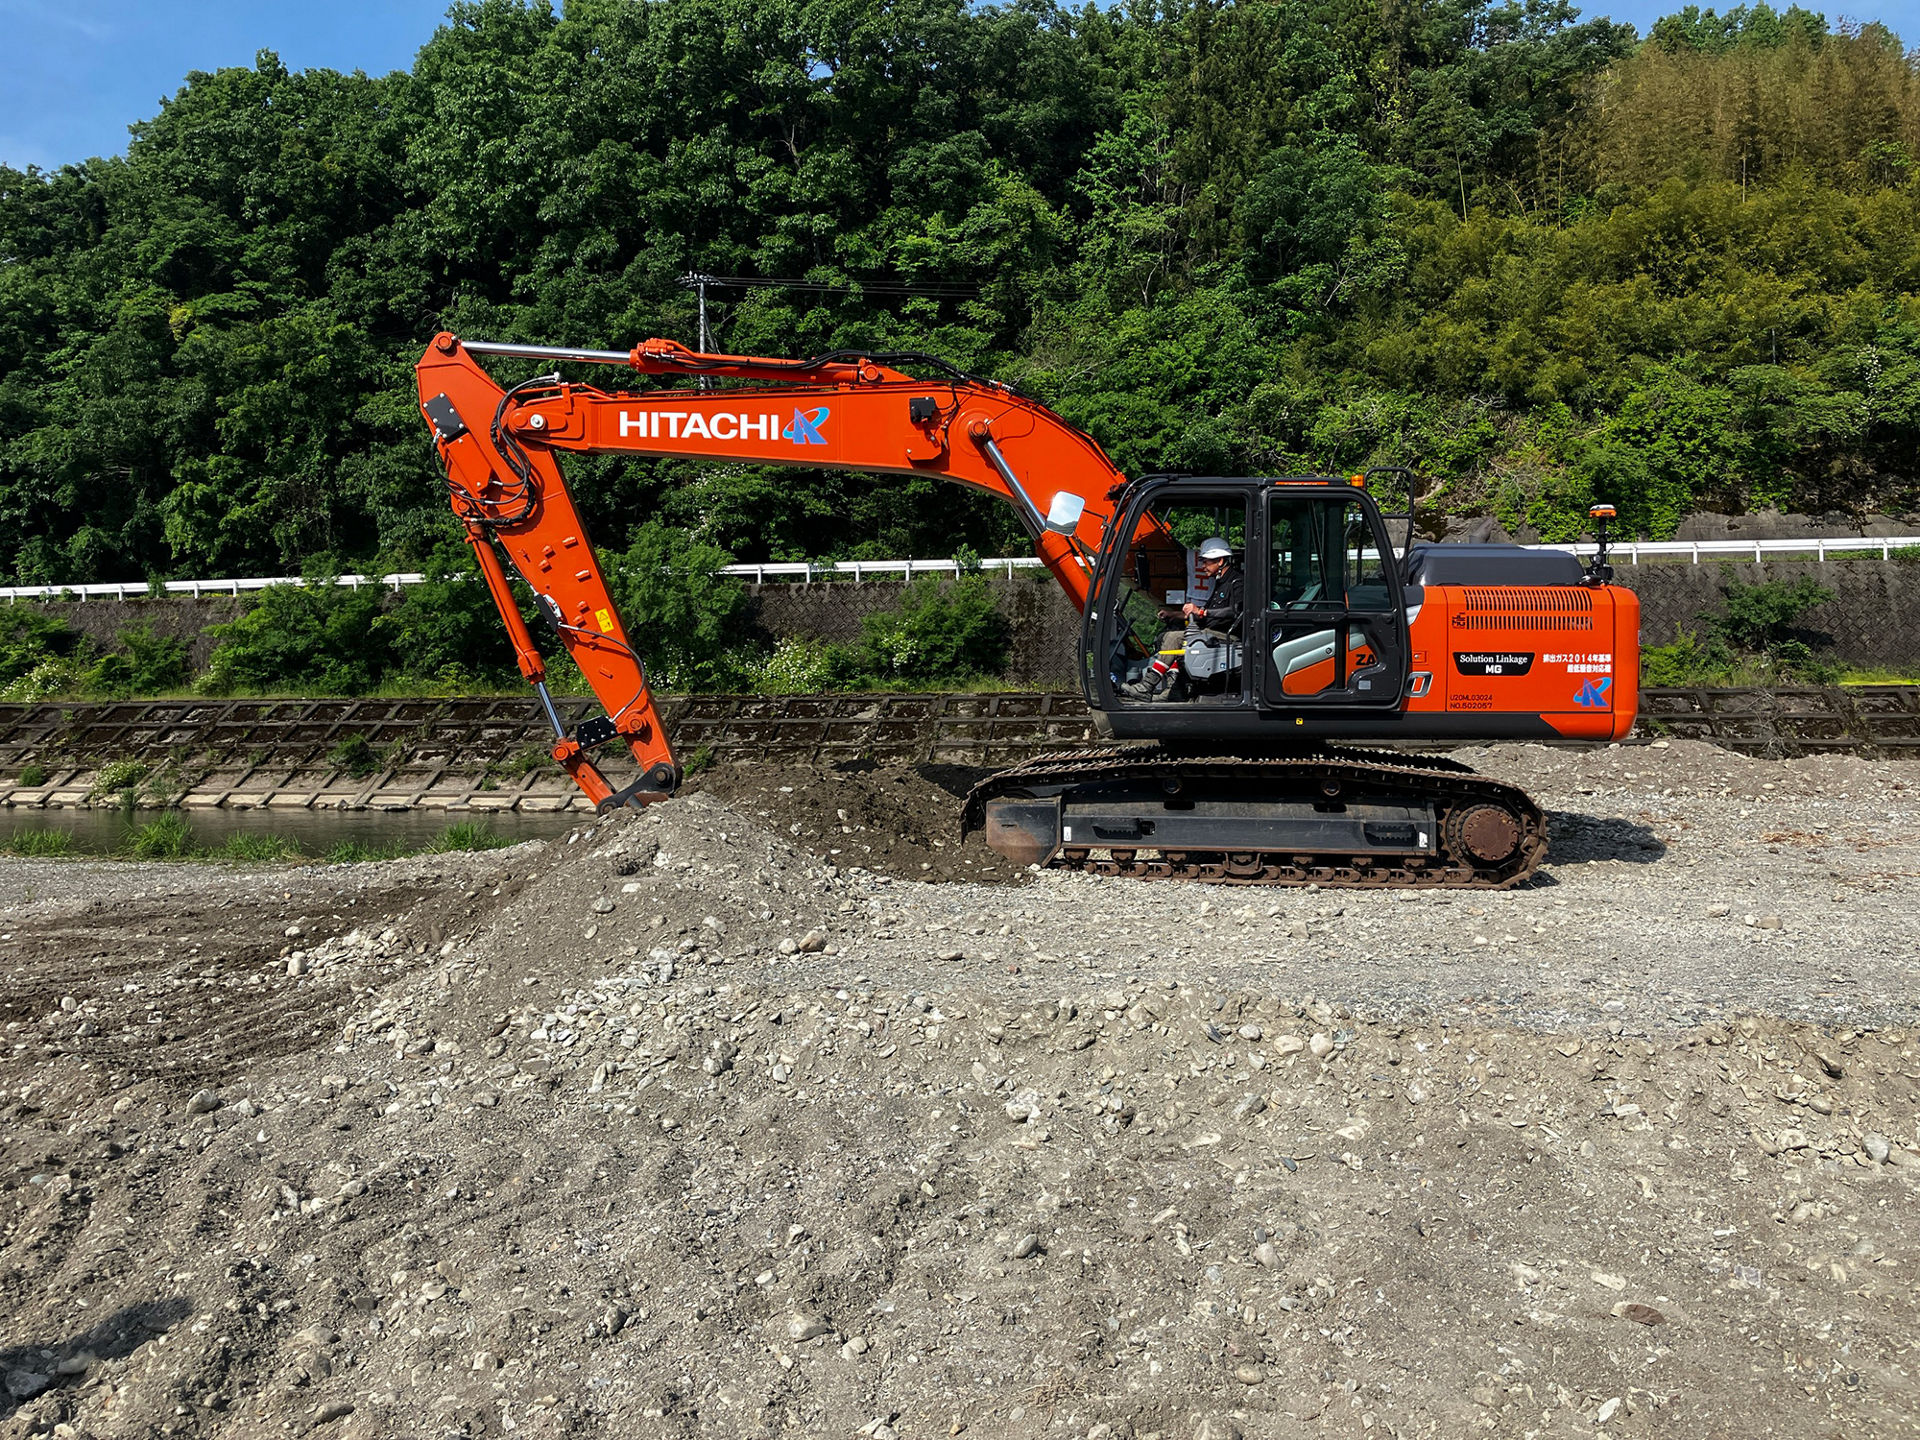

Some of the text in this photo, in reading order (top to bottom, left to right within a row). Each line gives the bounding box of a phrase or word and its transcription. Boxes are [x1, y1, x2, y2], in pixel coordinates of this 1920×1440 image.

[619, 411, 779, 440] HITACHI
[1459, 654, 1528, 665] Solution Linkage
[1485, 664, 1502, 674] MG
